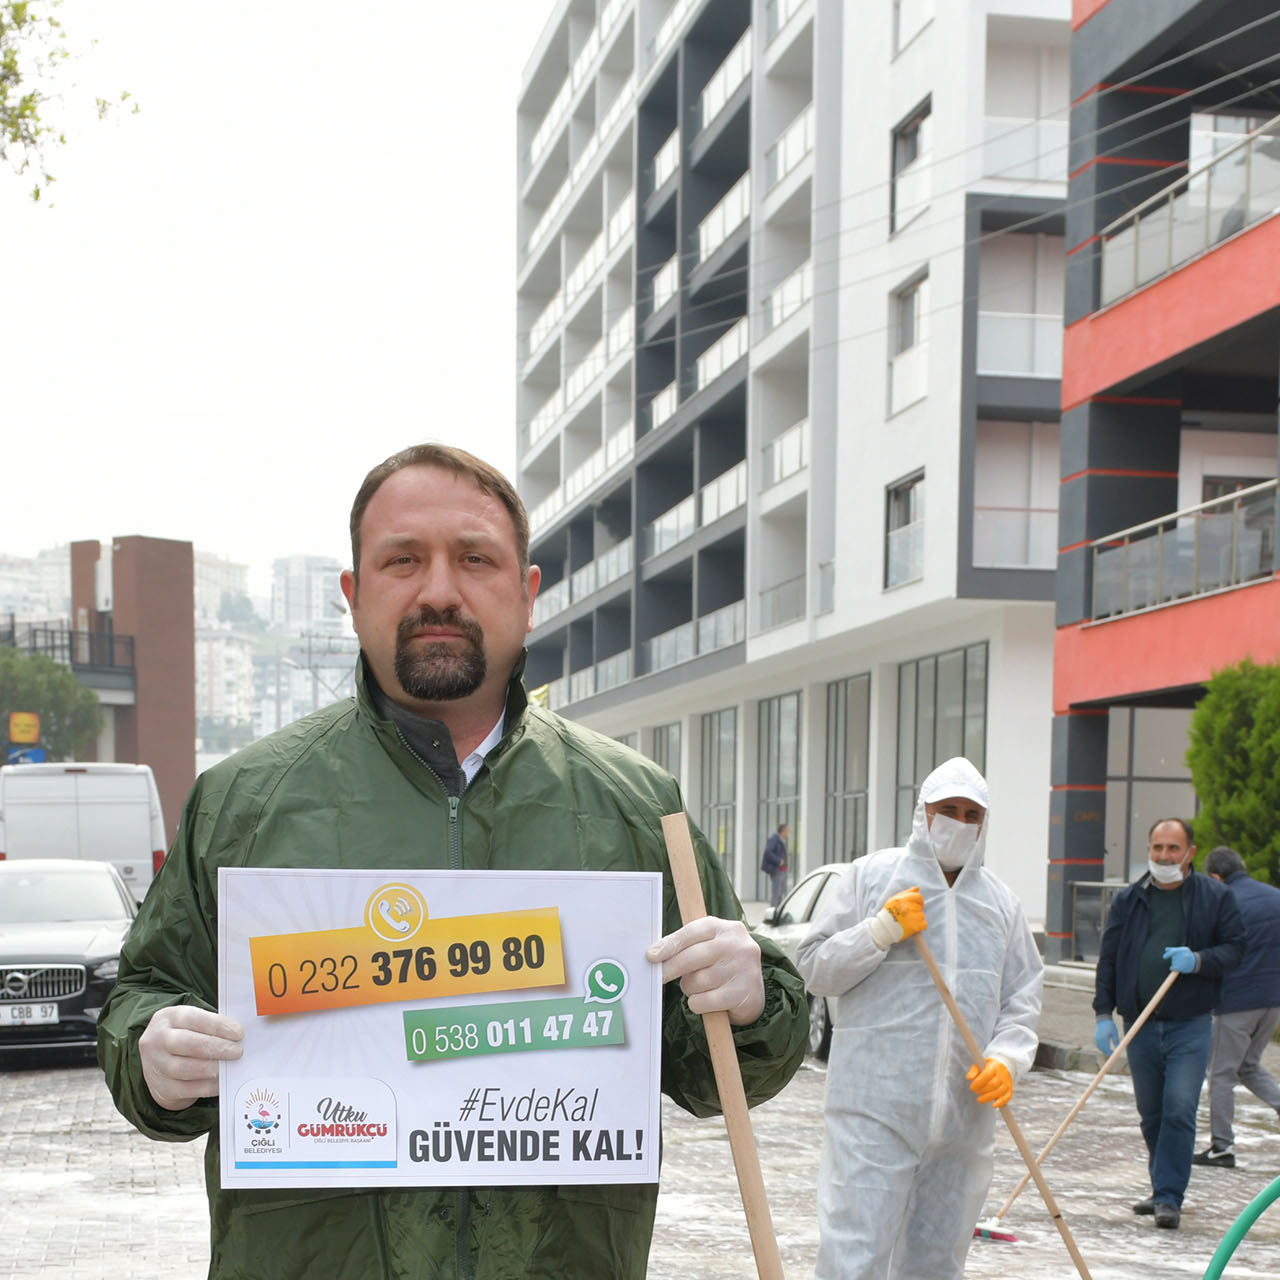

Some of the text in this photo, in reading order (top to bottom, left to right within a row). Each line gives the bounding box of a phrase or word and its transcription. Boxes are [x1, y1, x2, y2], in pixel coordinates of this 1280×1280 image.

[268, 933, 546, 998] 0 232 376 99 80
[10, 1006, 32, 1019] CBB
[40, 1005, 55, 1018] 97
[412, 1009, 614, 1055] 0 538 011 47 47
[316, 1096, 368, 1124] Utku
[458, 1087, 599, 1122] #EvdeKal
[297, 1123, 388, 1140] GÜMRÜKÇÜ
[409, 1121, 644, 1163] GÜVENDE KAL!
